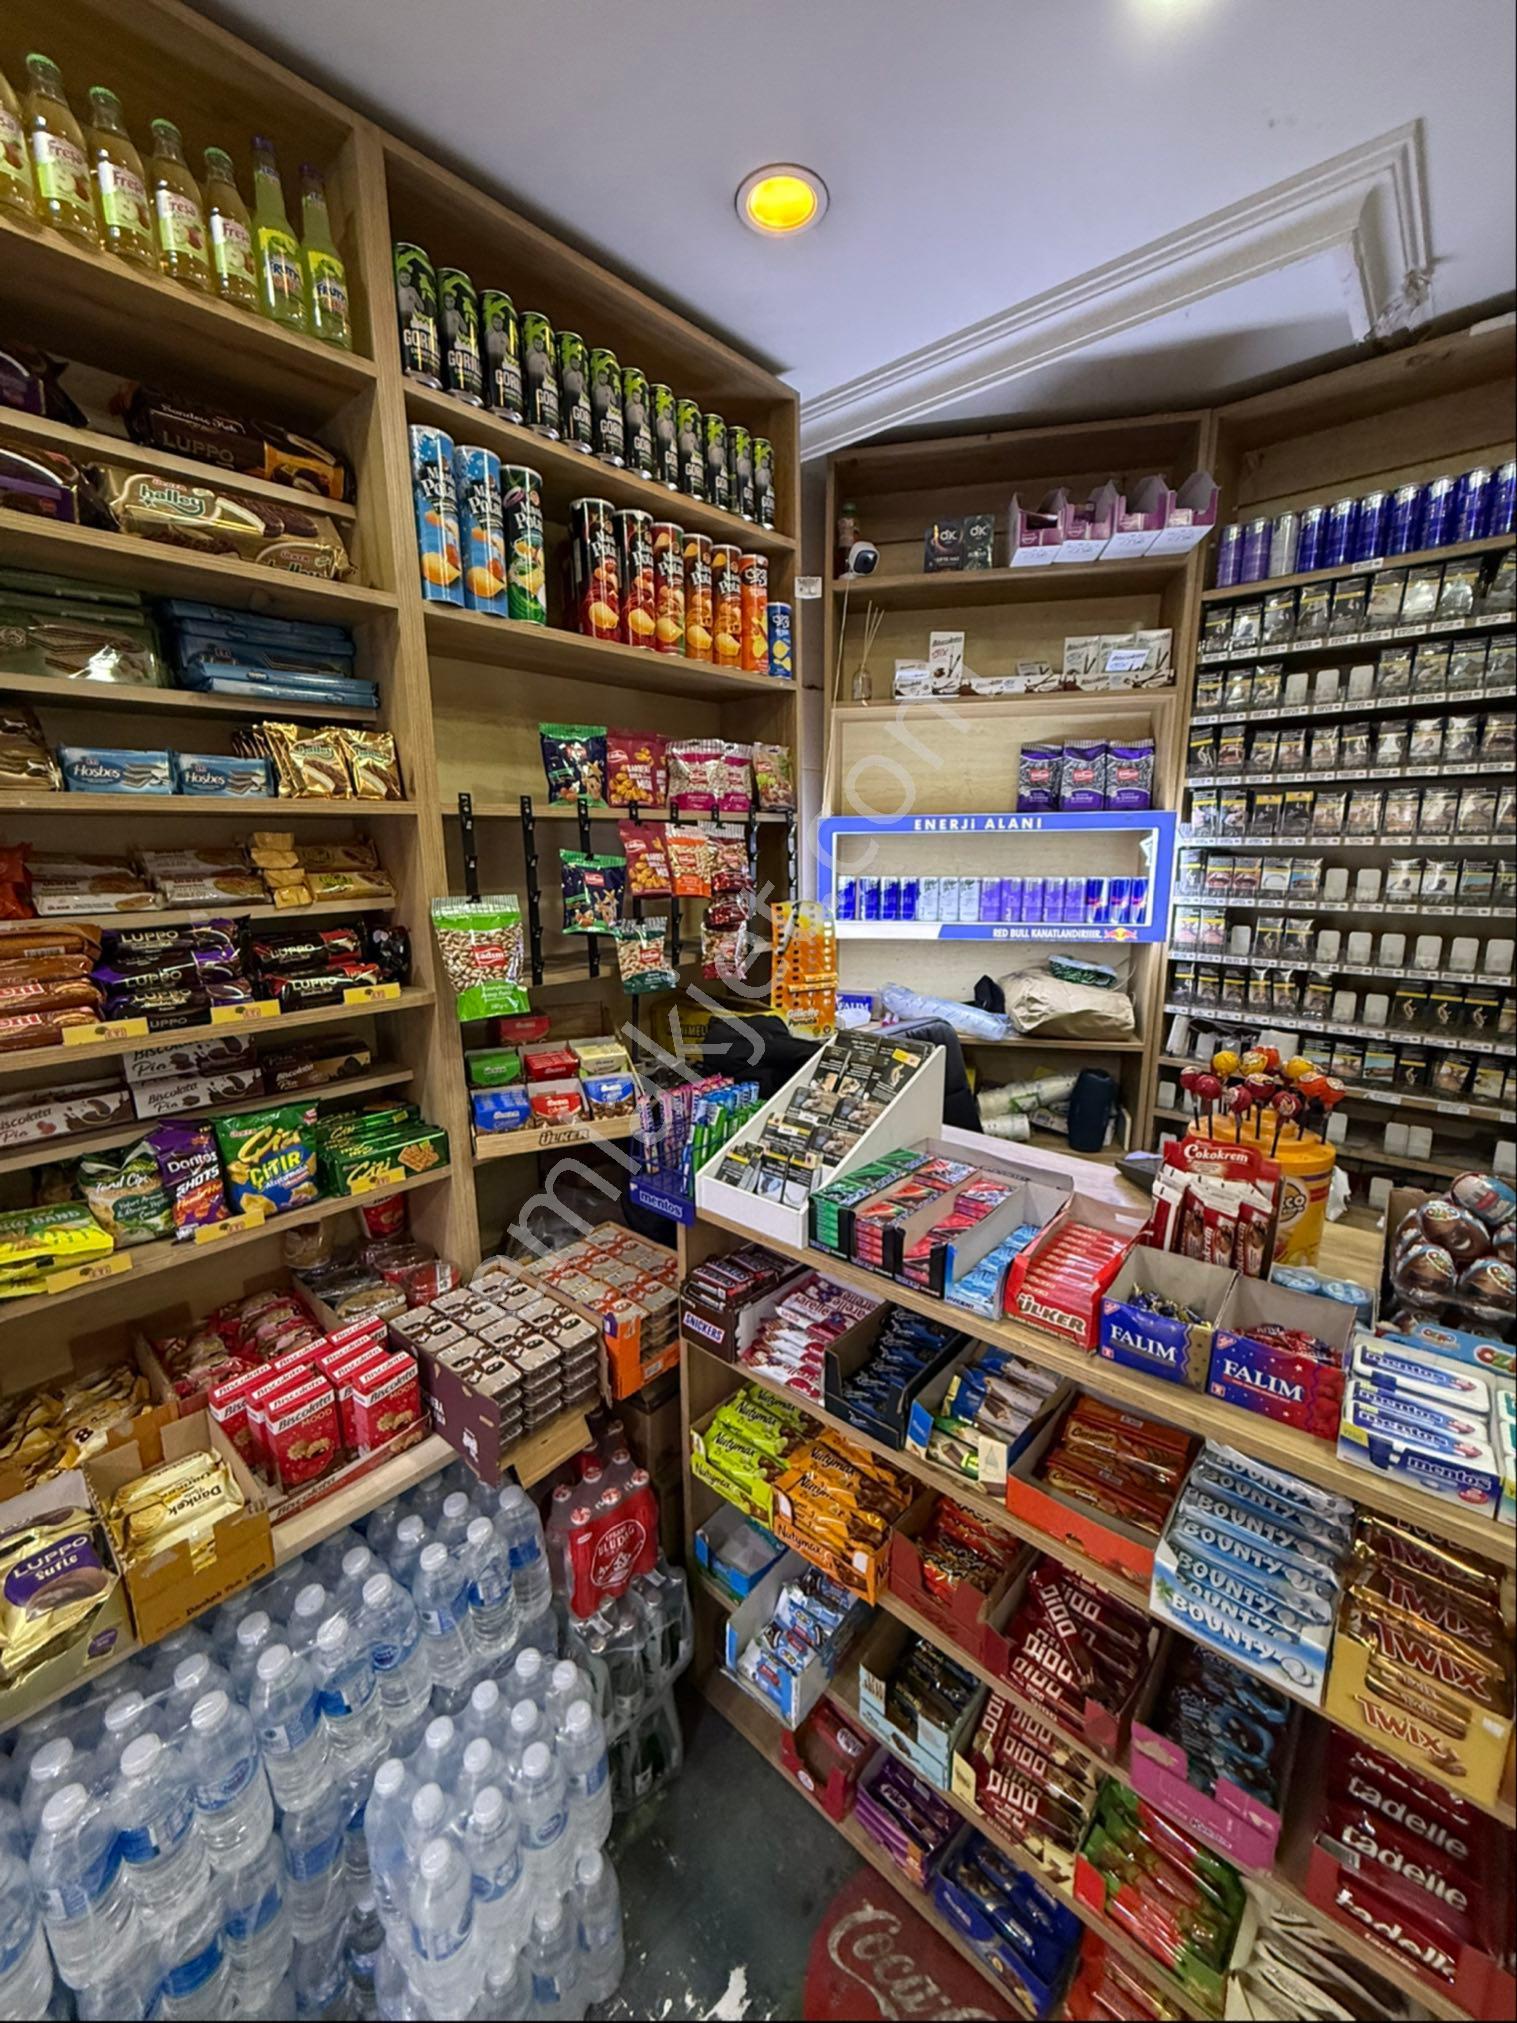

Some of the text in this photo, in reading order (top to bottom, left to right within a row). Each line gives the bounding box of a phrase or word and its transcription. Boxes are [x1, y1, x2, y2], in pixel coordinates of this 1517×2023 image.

[984, 817, 1042, 830] ALANI
[121, 930, 179, 943] LUPPO
[148, 1016, 188, 1029] UPPO
[148, 1081, 199, 1104] Biscolata
[0, 1107, 51, 1131] iscolata
[538, 1128, 590, 1146] ÜLKER
[1184, 1144, 1248, 1163] Çokokrem
[167, 1151, 218, 1173] Doritos
[176, 1165, 220, 1197] SHOTS
[639, 1191, 683, 1218] mentos
[685, 1312, 724, 1343] SNICKERS
[1018, 1293, 1086, 1333] ÜLKER
[1110, 1324, 1178, 1362] FALIM
[1223, 1358, 1305, 1403] FALIM
[1366, 1351, 1447, 1383] mentos
[370, 1367, 417, 1402] Biscolata
[389, 1381, 417, 1400] MOOD
[278, 1394, 332, 1431] Biscolata
[302, 1408, 333, 1427] MOOD
[735, 1401, 778, 1426] Nutymax
[1358, 1389, 1443, 1424] mentos
[714, 1431, 757, 1458] Nutymax
[1358, 1411, 1449, 1448] mentos
[810, 1446, 858, 1476] Nutymax
[1407, 1456, 1492, 1491] mentos
[168, 1484, 222, 1516] Dankek
[1203, 1468, 1297, 1519] BOUNTY
[1198, 1496, 1295, 1548] BOUNTY
[777, 1523, 822, 1555] Nutymax
[1184, 1520, 1284, 1575] BOUNTY
[13, 1536, 88, 1579] LUPPO
[1178, 1551, 1276, 1614] BOUNTY
[1381, 1567, 1493, 1648] TWIX
[1171, 1592, 1278, 1660] BOUNTY
[1367, 1613, 1492, 1702] TWIX
[1354, 1694, 1447, 1759] TWIX
[1348, 1775, 1469, 1860] tadelle
[1342, 1825, 1468, 1912] tadelle
